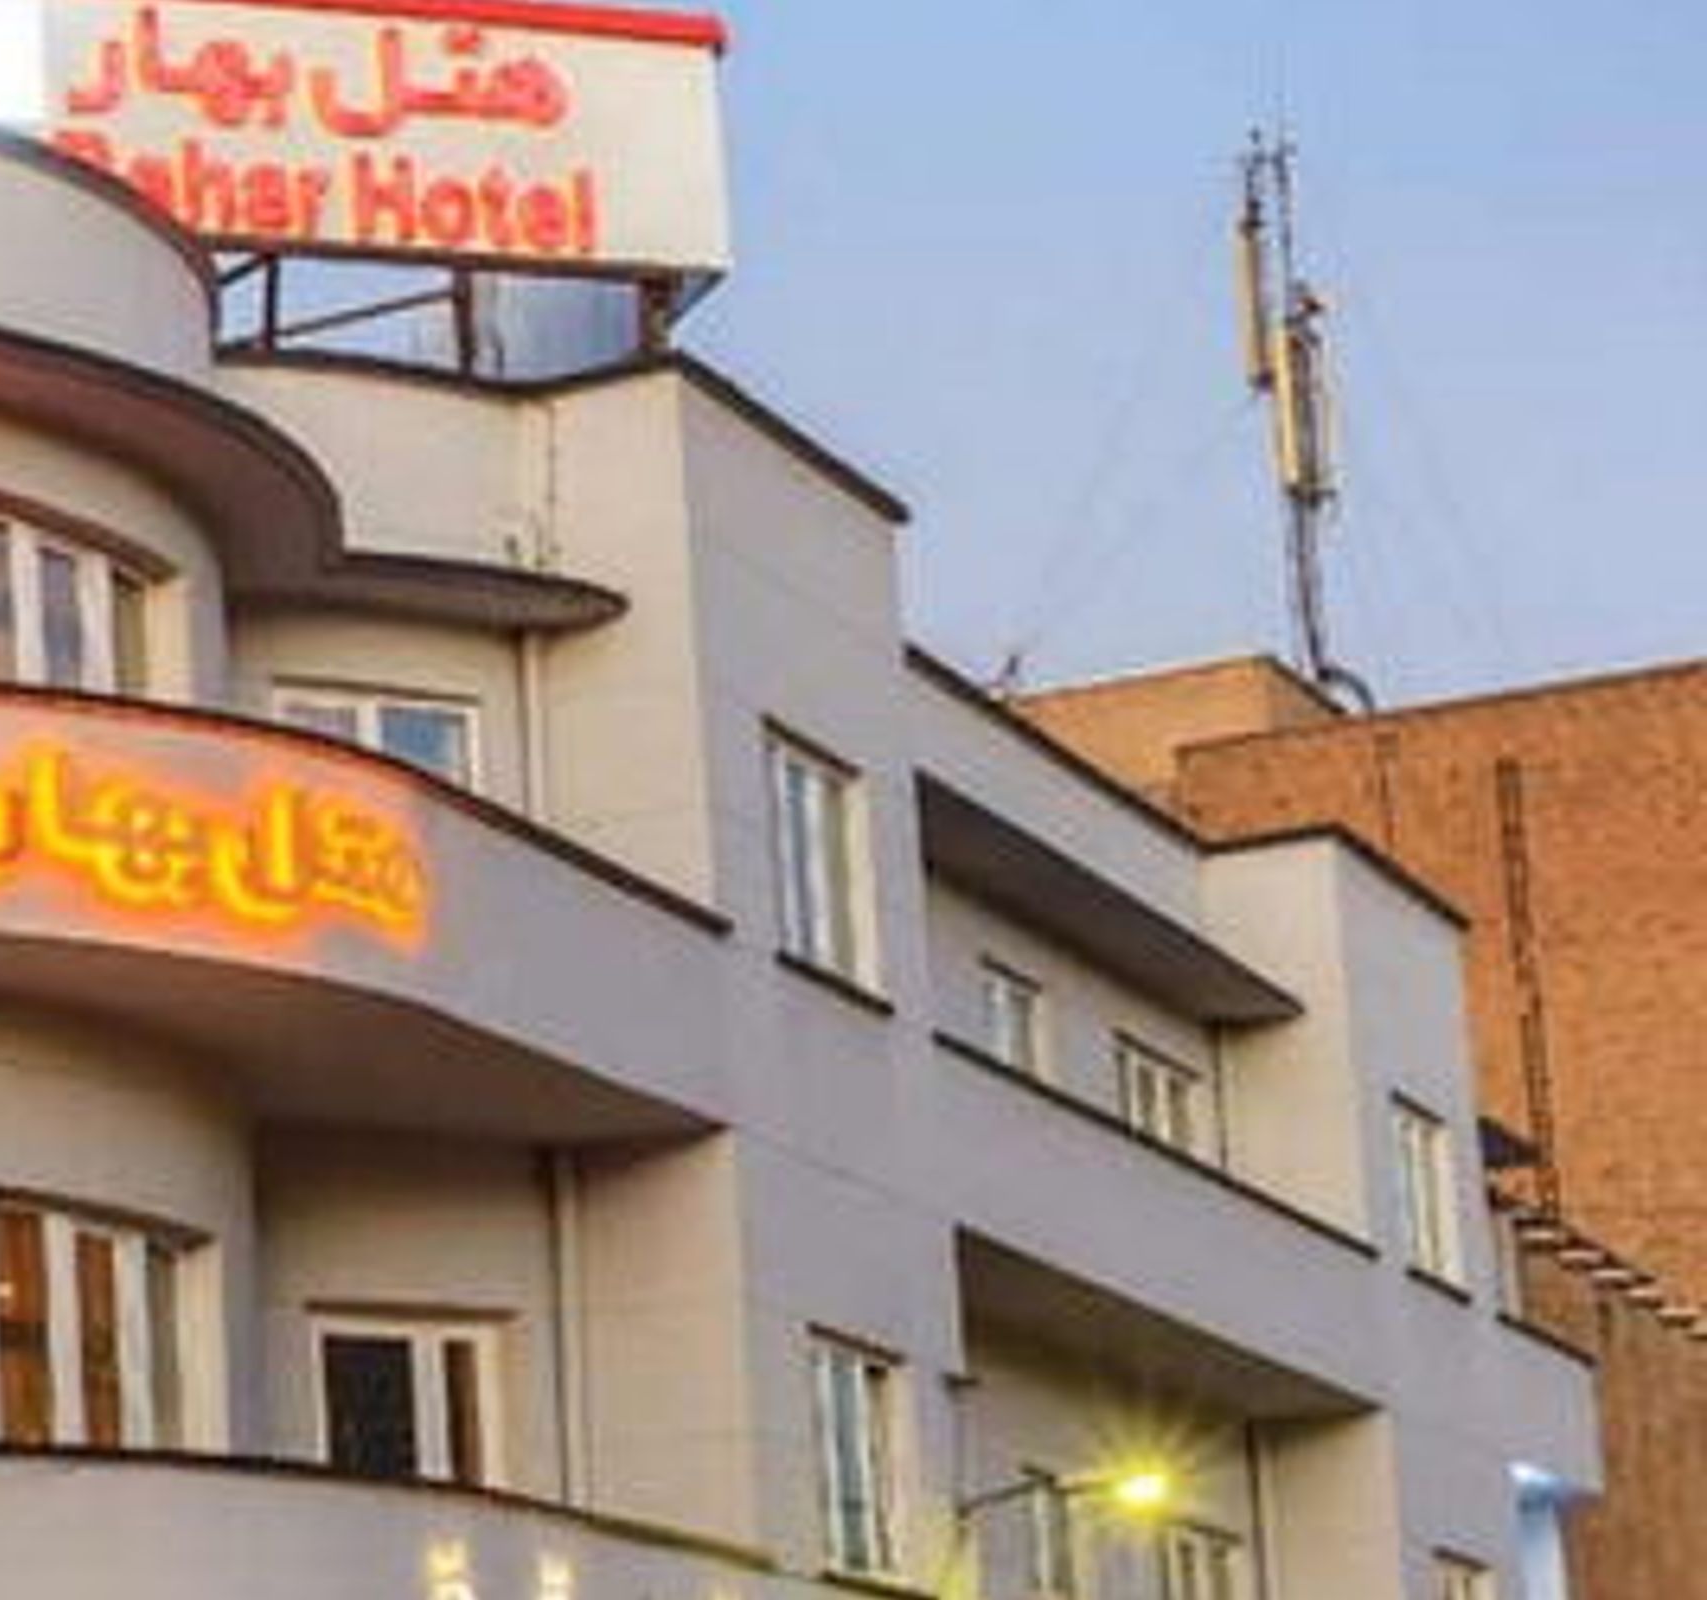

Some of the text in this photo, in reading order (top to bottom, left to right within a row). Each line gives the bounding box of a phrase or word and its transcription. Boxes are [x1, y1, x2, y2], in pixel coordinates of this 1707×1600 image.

[65, 6, 569, 138] هتل بهار
[352, 150, 601, 252] Hotel
[207, 784, 425, 940] هتل
